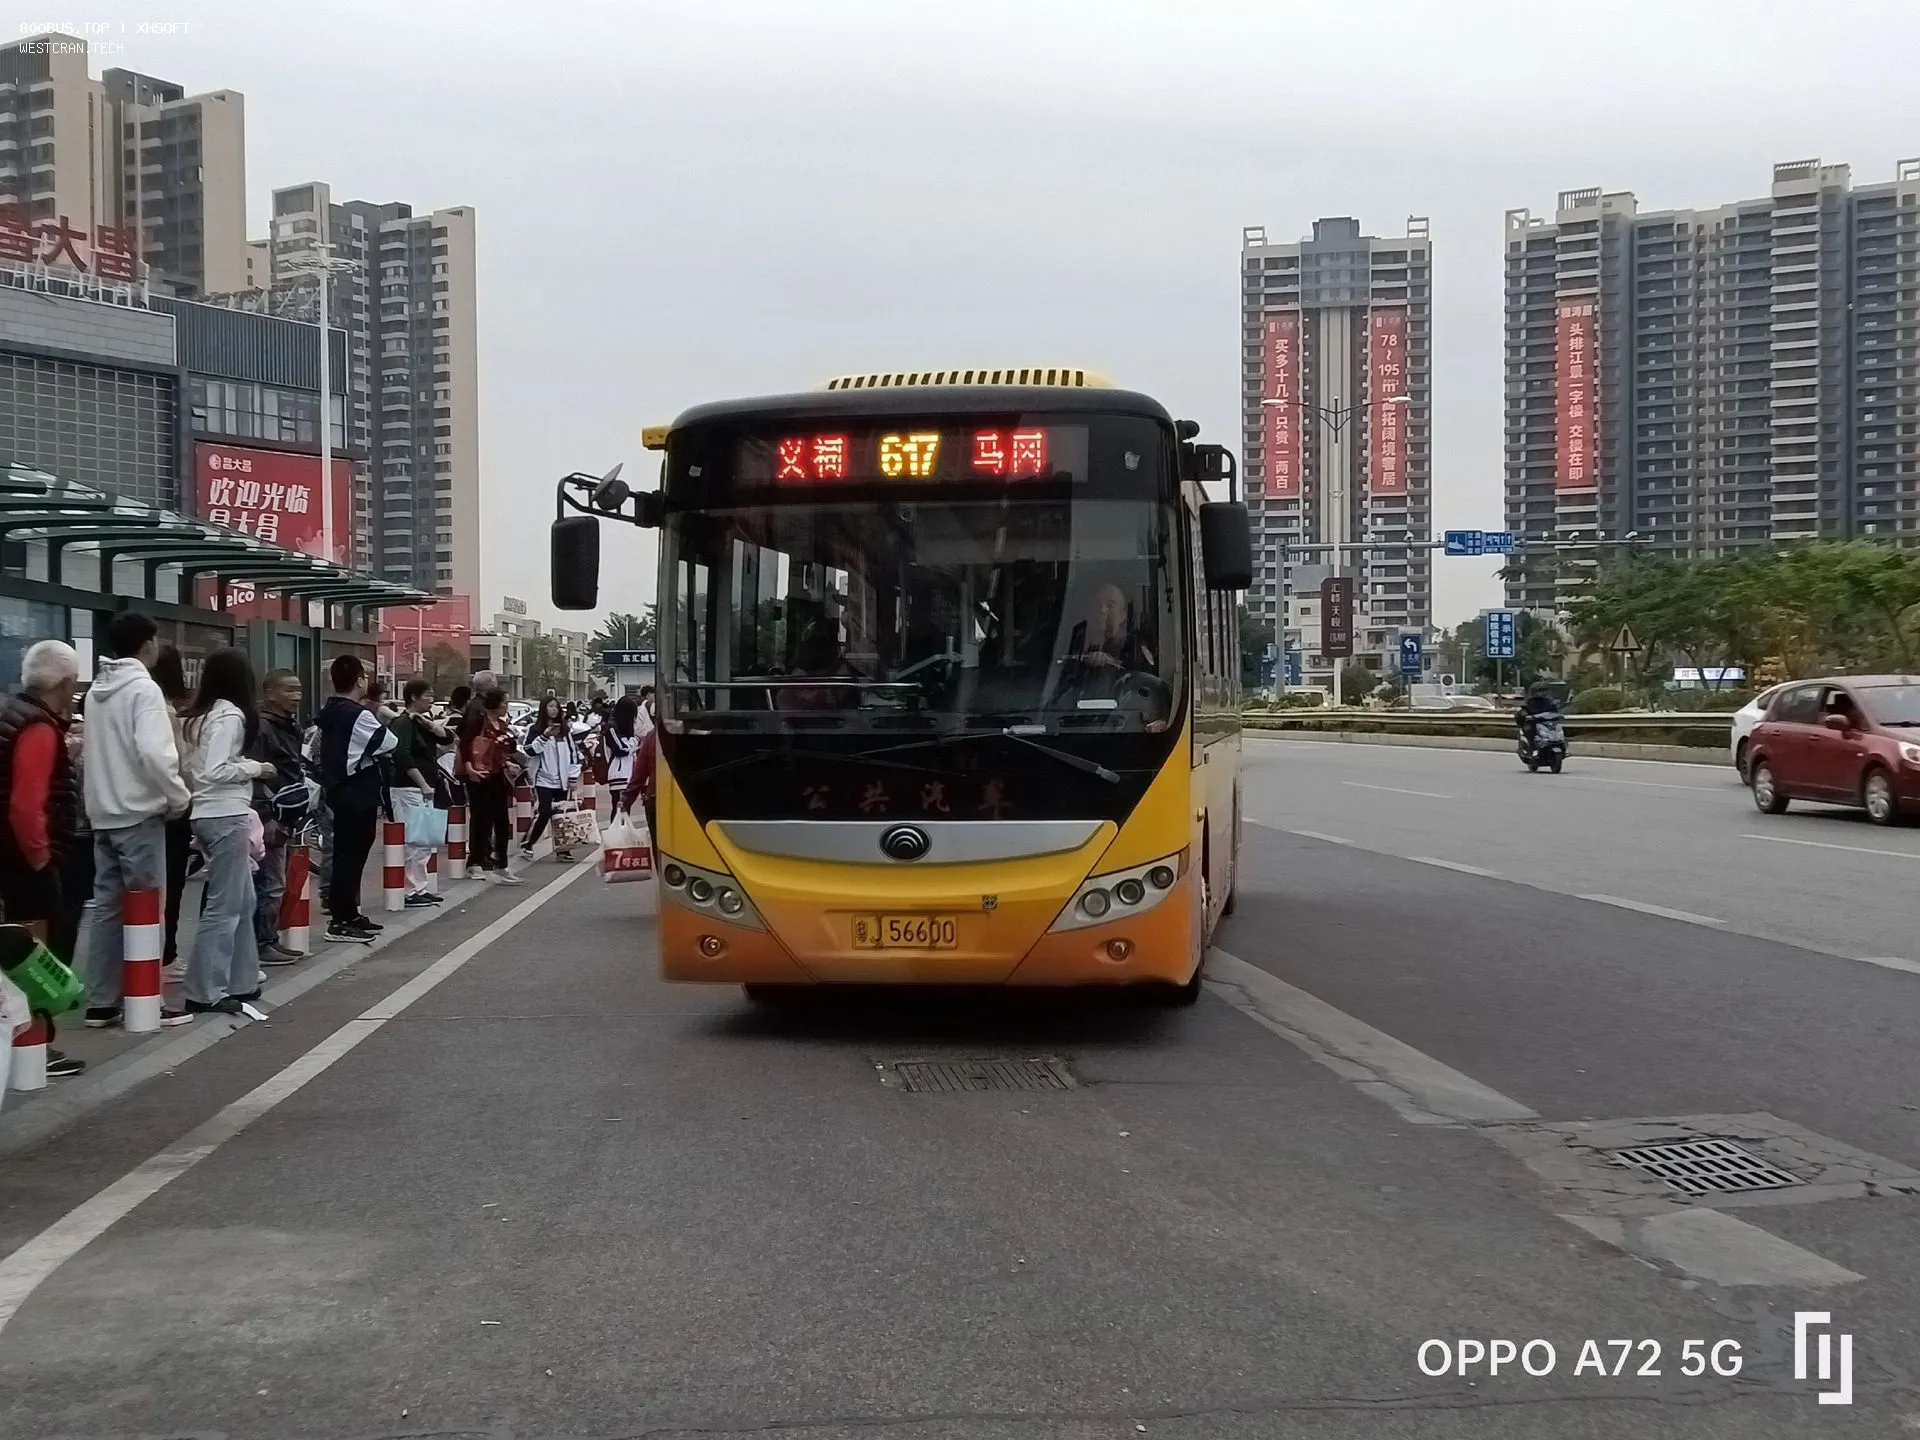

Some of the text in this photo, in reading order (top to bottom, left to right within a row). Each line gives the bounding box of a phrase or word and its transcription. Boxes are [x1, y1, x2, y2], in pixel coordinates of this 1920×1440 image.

[881, 434, 939, 477] 617
[208, 477, 311, 514] 欢迎光临
[801, 778, 1012, 820] 公共汽车
